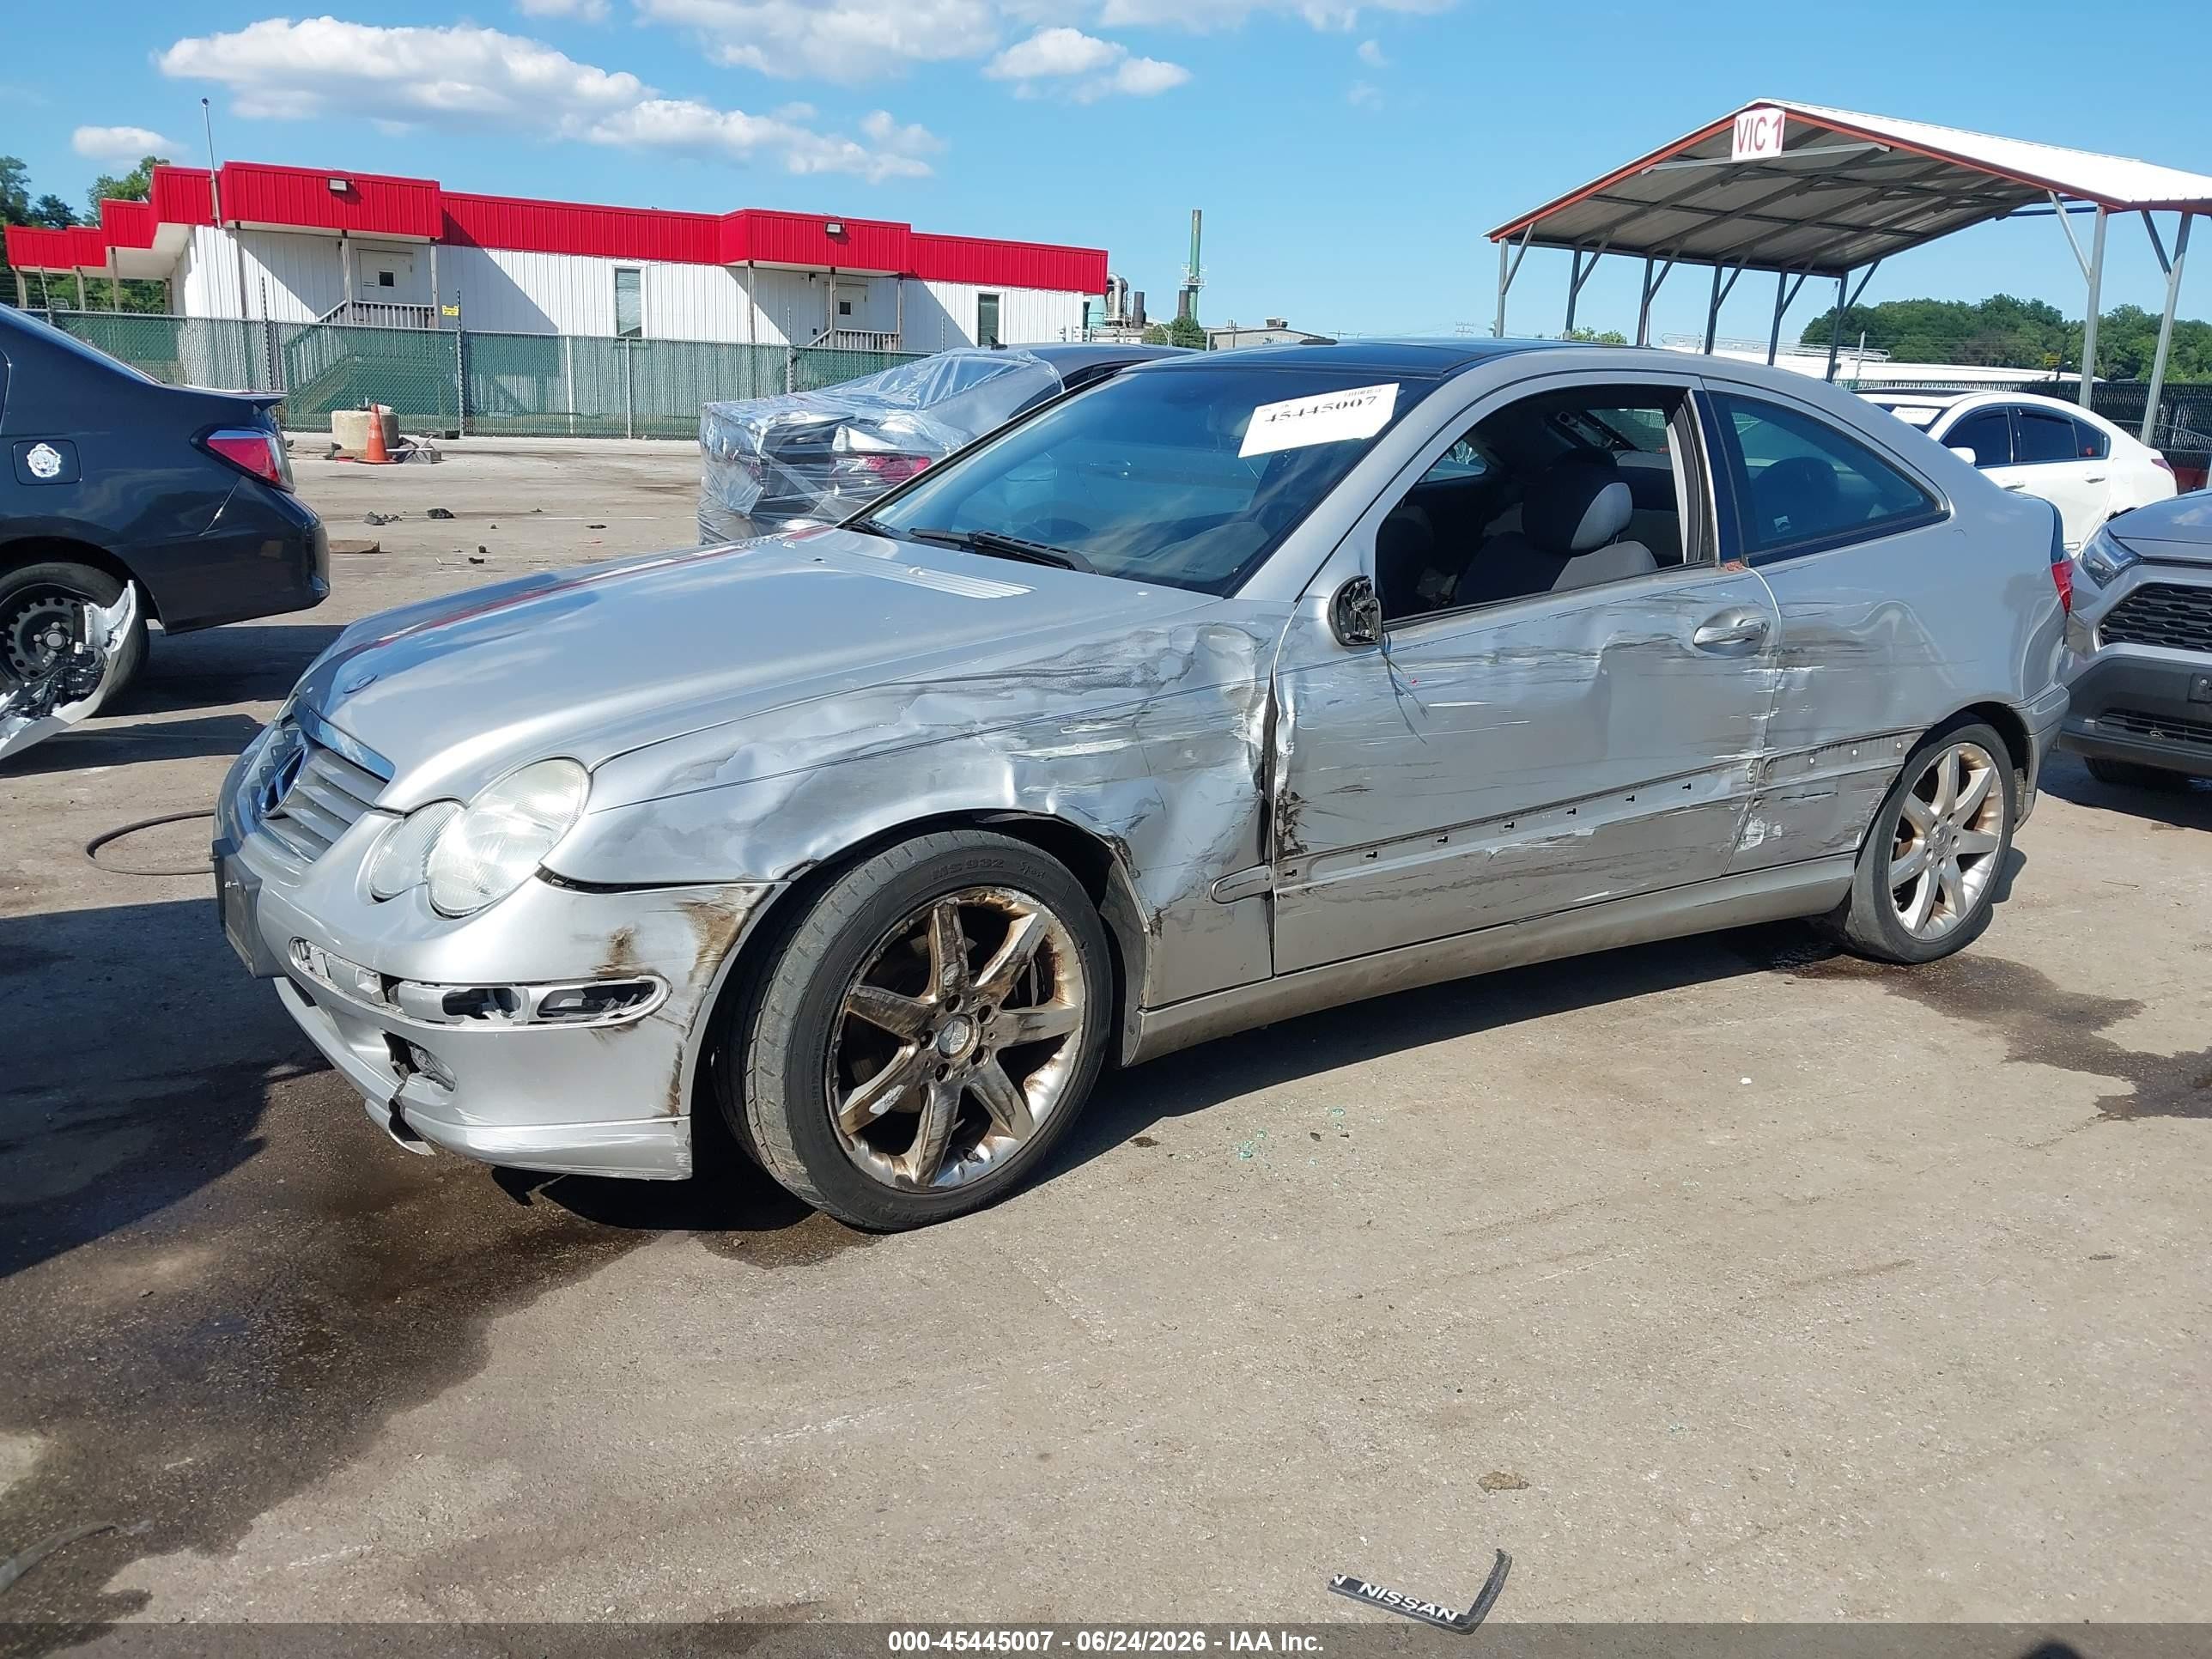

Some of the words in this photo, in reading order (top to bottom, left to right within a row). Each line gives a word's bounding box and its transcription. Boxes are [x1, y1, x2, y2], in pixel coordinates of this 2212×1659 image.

[1737, 116, 1768, 153] VIC
[1772, 113, 1784, 149] 1
[1264, 396, 1377, 424] 45445007
[1357, 1583, 1459, 1622] NISSAN
